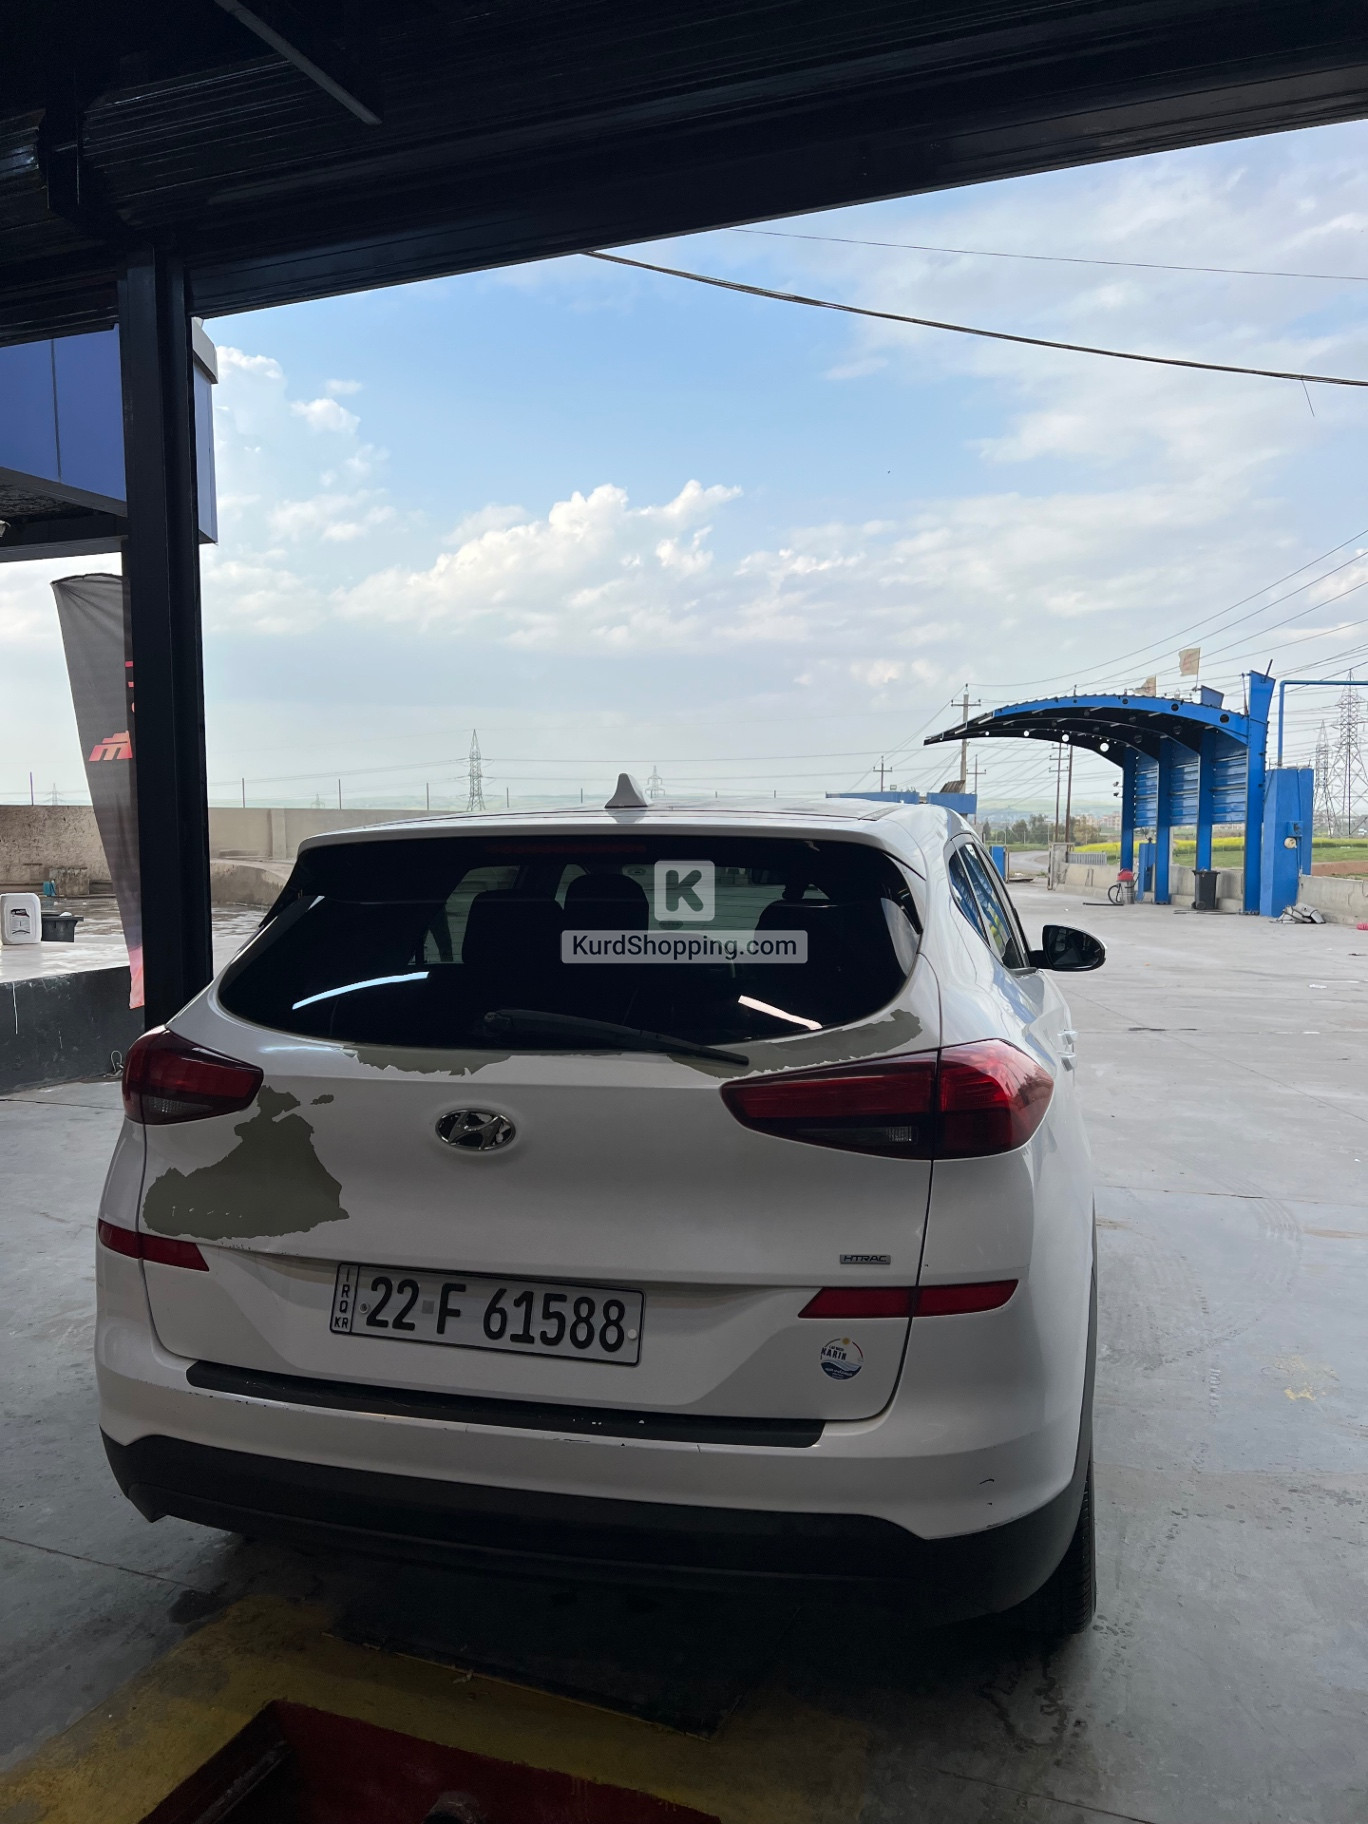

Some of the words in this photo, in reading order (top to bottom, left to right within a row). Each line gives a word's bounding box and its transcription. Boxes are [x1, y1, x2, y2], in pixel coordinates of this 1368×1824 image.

[843, 1255, 887, 1263] HTRAC
[366, 1276, 420, 1331] 22
[436, 1283, 467, 1334] F
[483, 1288, 625, 1352] 61588
[334, 1316, 349, 1329] KR
